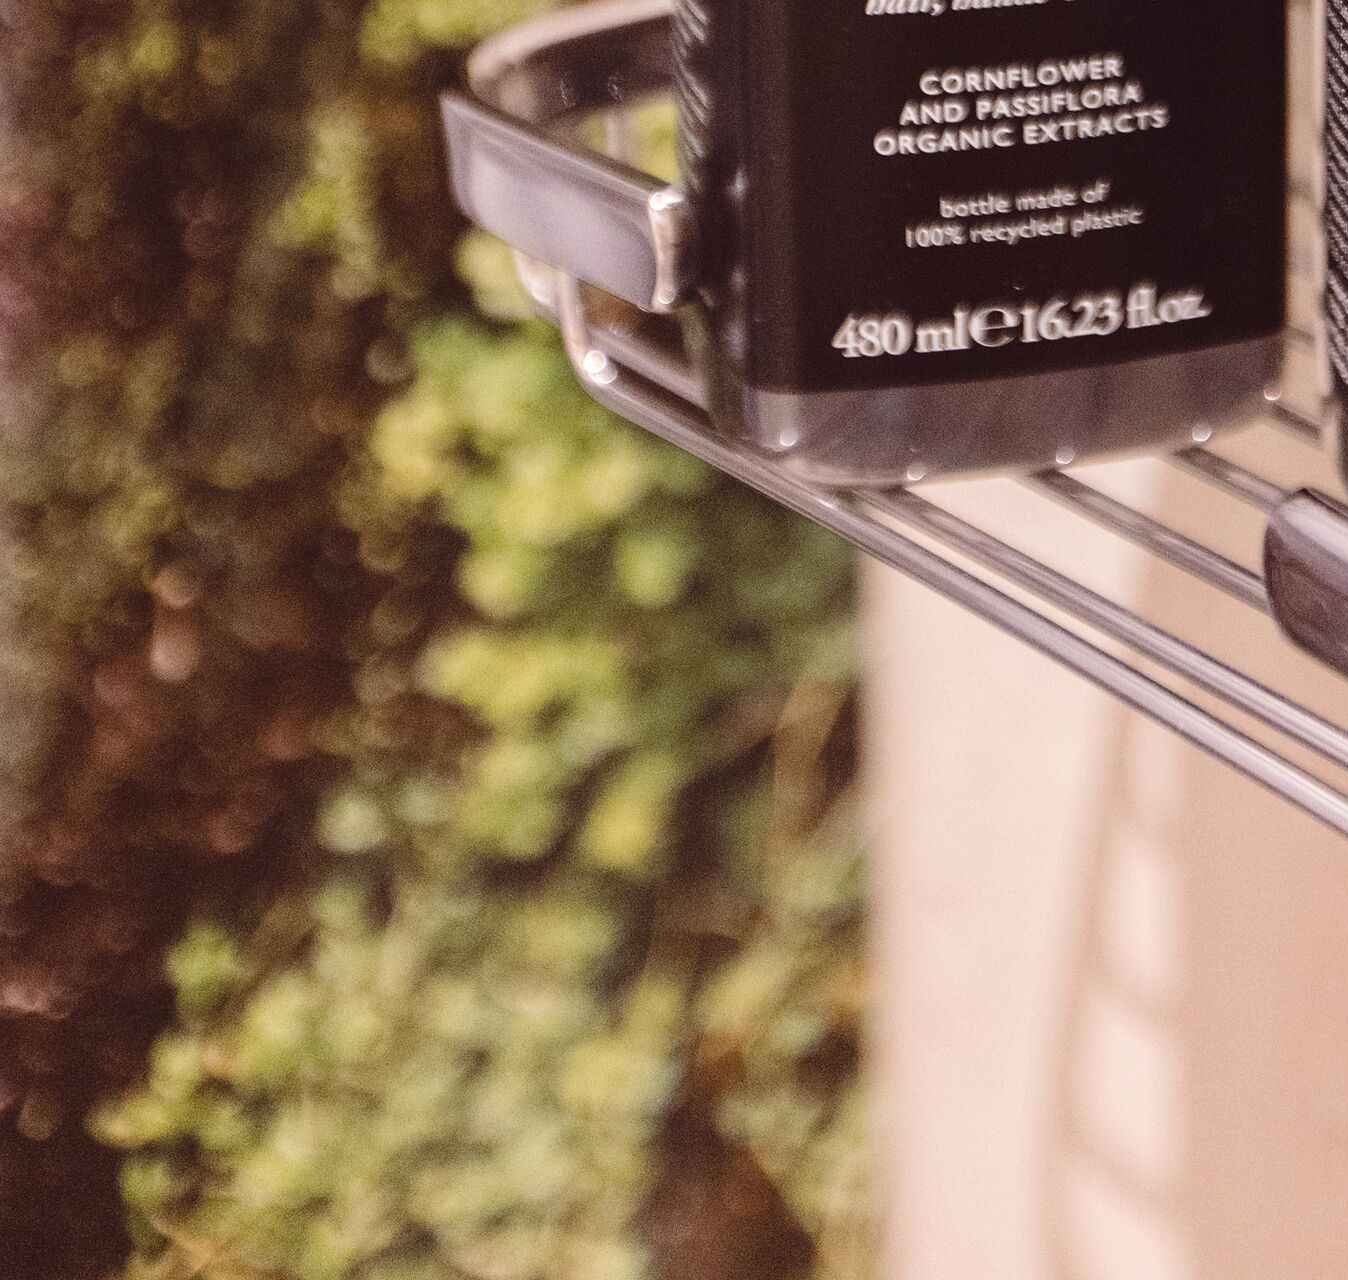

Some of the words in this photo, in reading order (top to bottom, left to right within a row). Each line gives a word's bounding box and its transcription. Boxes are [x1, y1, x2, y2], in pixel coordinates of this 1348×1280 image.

[918, 52, 1125, 96] CORNFLOWER
[899, 99, 971, 125] AND
[976, 80, 1143, 120] PASSIFLORA
[873, 126, 1017, 157] ORGANIC
[1023, 106, 1171, 145] EXTRACTS
[939, 193, 1011, 218] bottle
[1015, 186, 1079, 210] made
[1083, 178, 1111, 203] of
[905, 224, 966, 248] 100%
[969, 215, 1067, 247] recycled
[1071, 205, 1145, 238] plastic
[832, 311, 913, 359] 480
[916, 302, 970, 354] ml
